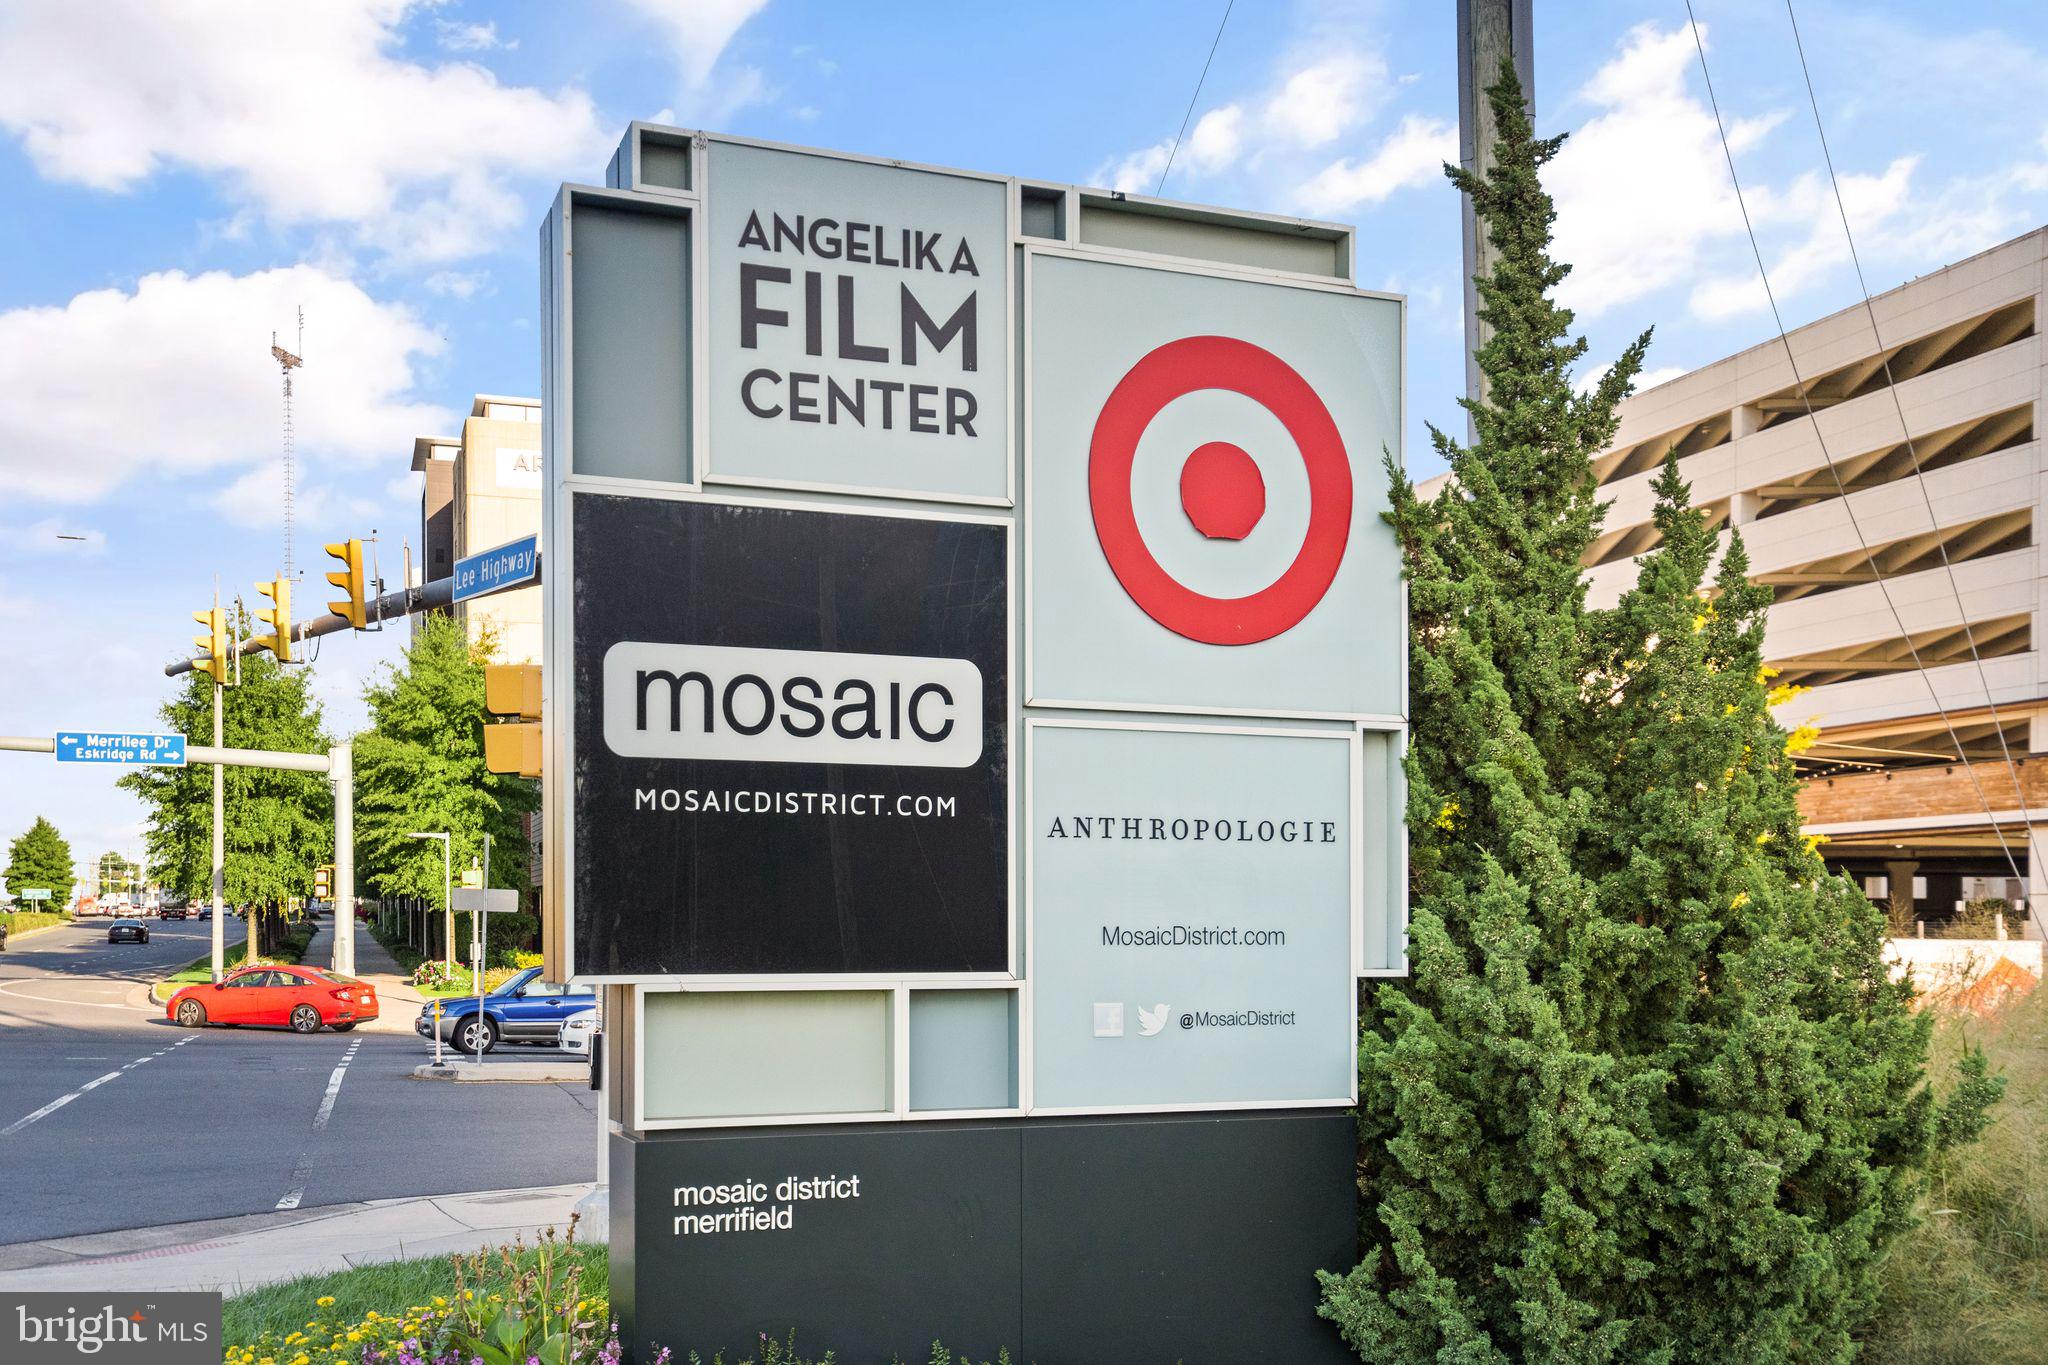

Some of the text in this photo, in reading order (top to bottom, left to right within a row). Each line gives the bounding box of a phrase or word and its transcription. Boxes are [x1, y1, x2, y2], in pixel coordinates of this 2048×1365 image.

[738, 209, 980, 277] ANGELIKA
[740, 262, 978, 372] FILM
[741, 368, 978, 438] CENTER
[456, 549, 533, 590] Lee Highway
[636, 669, 955, 743] mosaic
[75, 748, 157, 762] Eskridge Rd
[86, 735, 171, 749] Merrilee Dr
[635, 788, 956, 818] MOSAICDISTRICT.COM
[1048, 816, 1337, 843] ANTHROPOLOGIE
[1101, 926, 1286, 946] MosaicDistrict.com
[1179, 1010, 1296, 1030] @MosaicDistrict
[673, 1174, 860, 1206] mosaic district
[673, 1204, 793, 1235] merrifield
